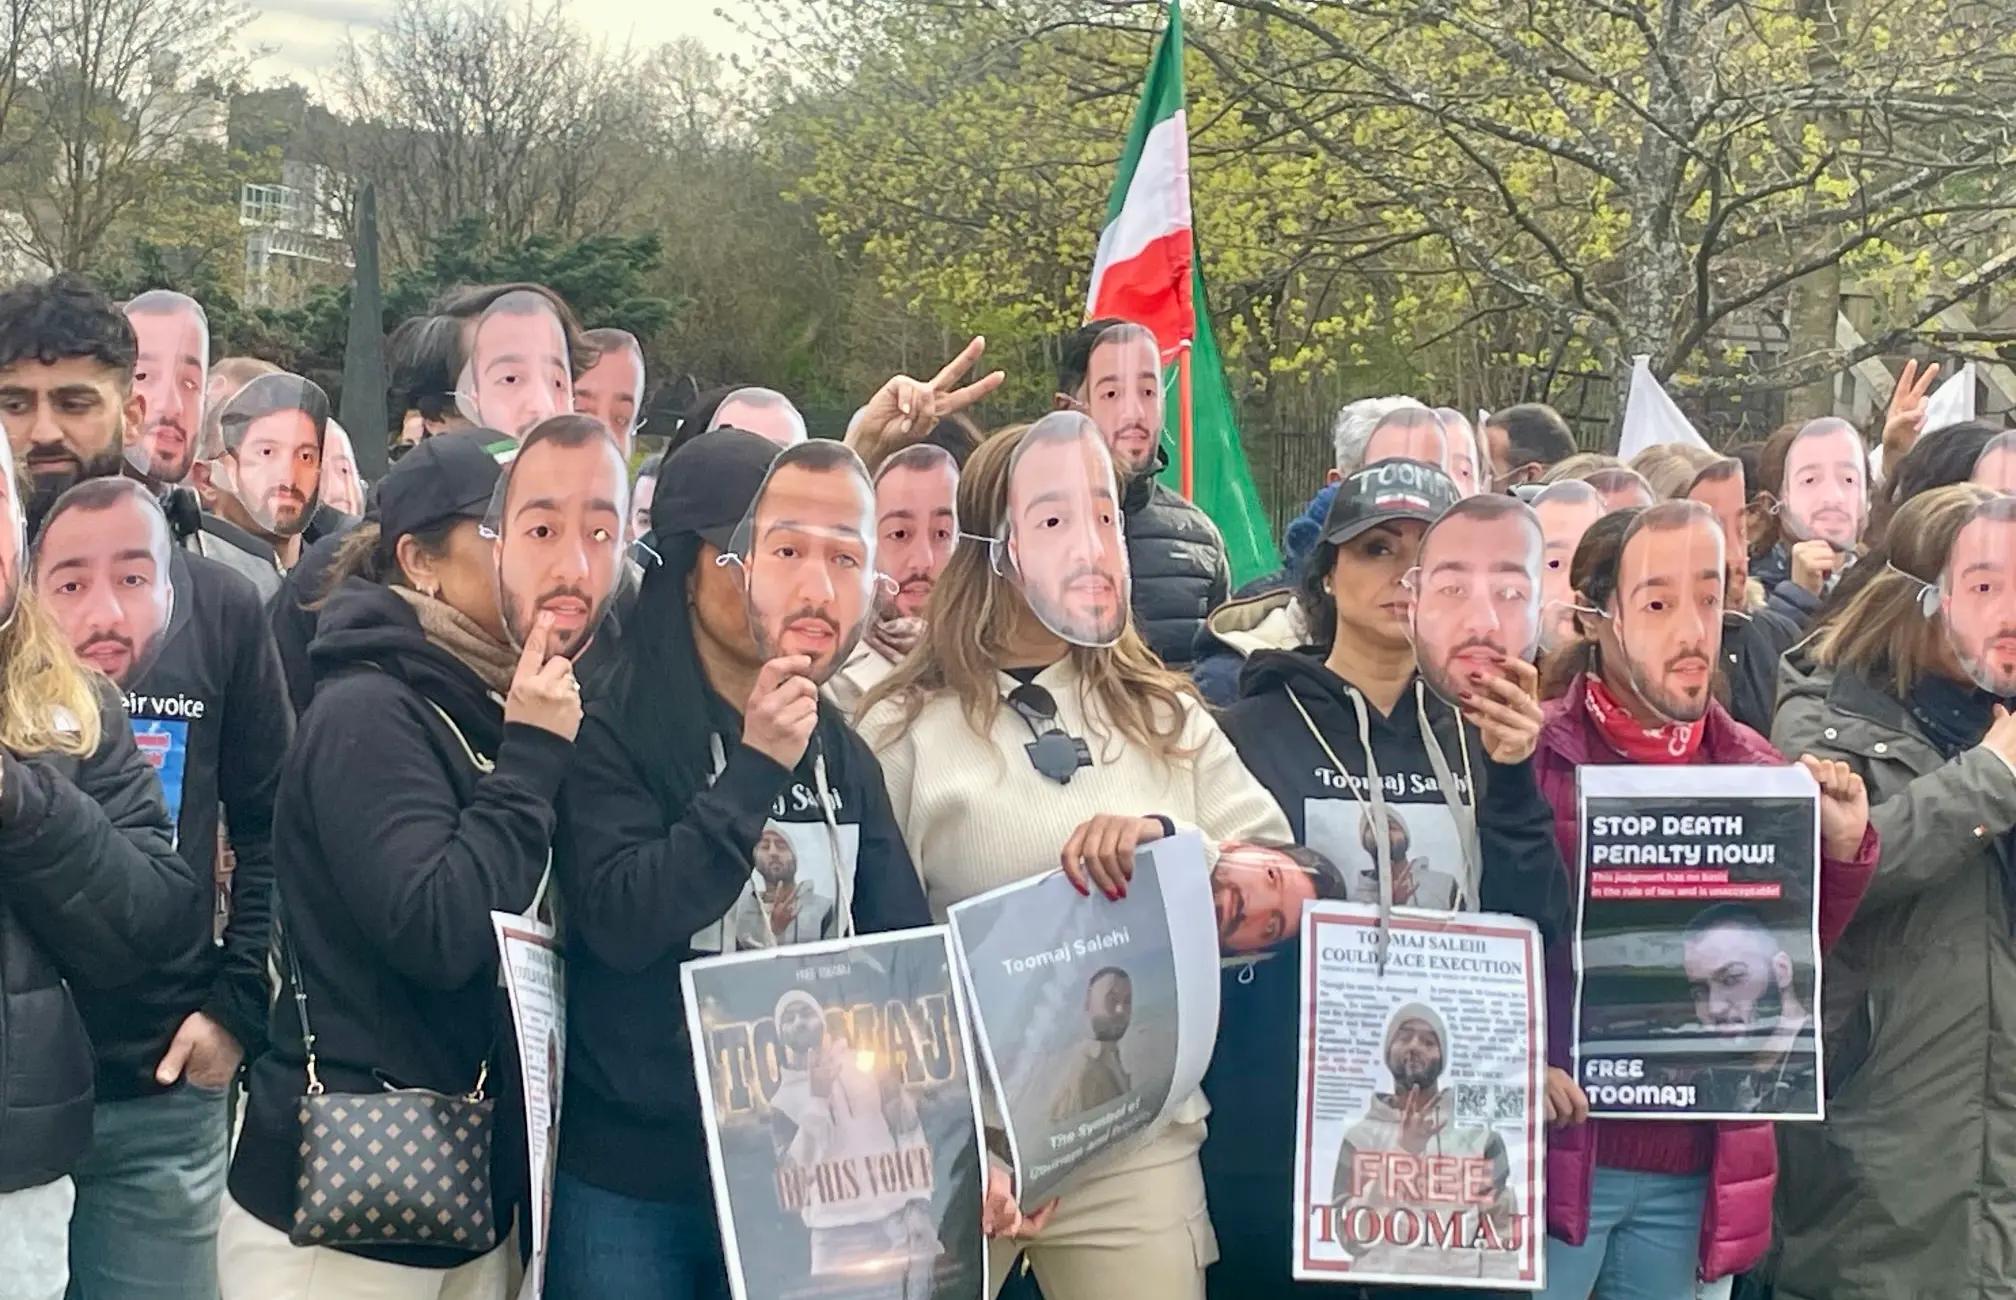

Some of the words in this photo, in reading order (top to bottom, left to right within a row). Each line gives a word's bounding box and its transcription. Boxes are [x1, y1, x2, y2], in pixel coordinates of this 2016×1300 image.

[122, 692, 147, 713] eir
[151, 694, 204, 718] voice
[1593, 816, 1657, 836] STOP
[1662, 816, 1743, 836] DEATH
[1592, 845, 1700, 865] PENALTY
[1707, 844, 1776, 864] NOW!
[1592, 872, 1613, 882] This
[1603, 886, 1621, 897] the
[1645, 886, 1657, 897] of
[1001, 941, 1072, 976] Toomaj
[1073, 925, 1130, 956] Salehi
[1357, 930, 1425, 949] TOMAJ
[1428, 936, 1487, 955] SALEHI
[1322, 947, 1379, 964] COULD
[1429, 956, 1522, 976] EXECUTION
[707, 993, 956, 1115] TOMAJ
[1586, 1059, 1645, 1078] FREE
[1585, 1085, 1696, 1107] TOOMAJ!
[815, 1159, 860, 1204] HIS
[864, 1147, 934, 1198] VOICE
[1352, 1152, 1495, 1204] FREE
[1311, 1204, 1527, 1251] TOOMAJ
